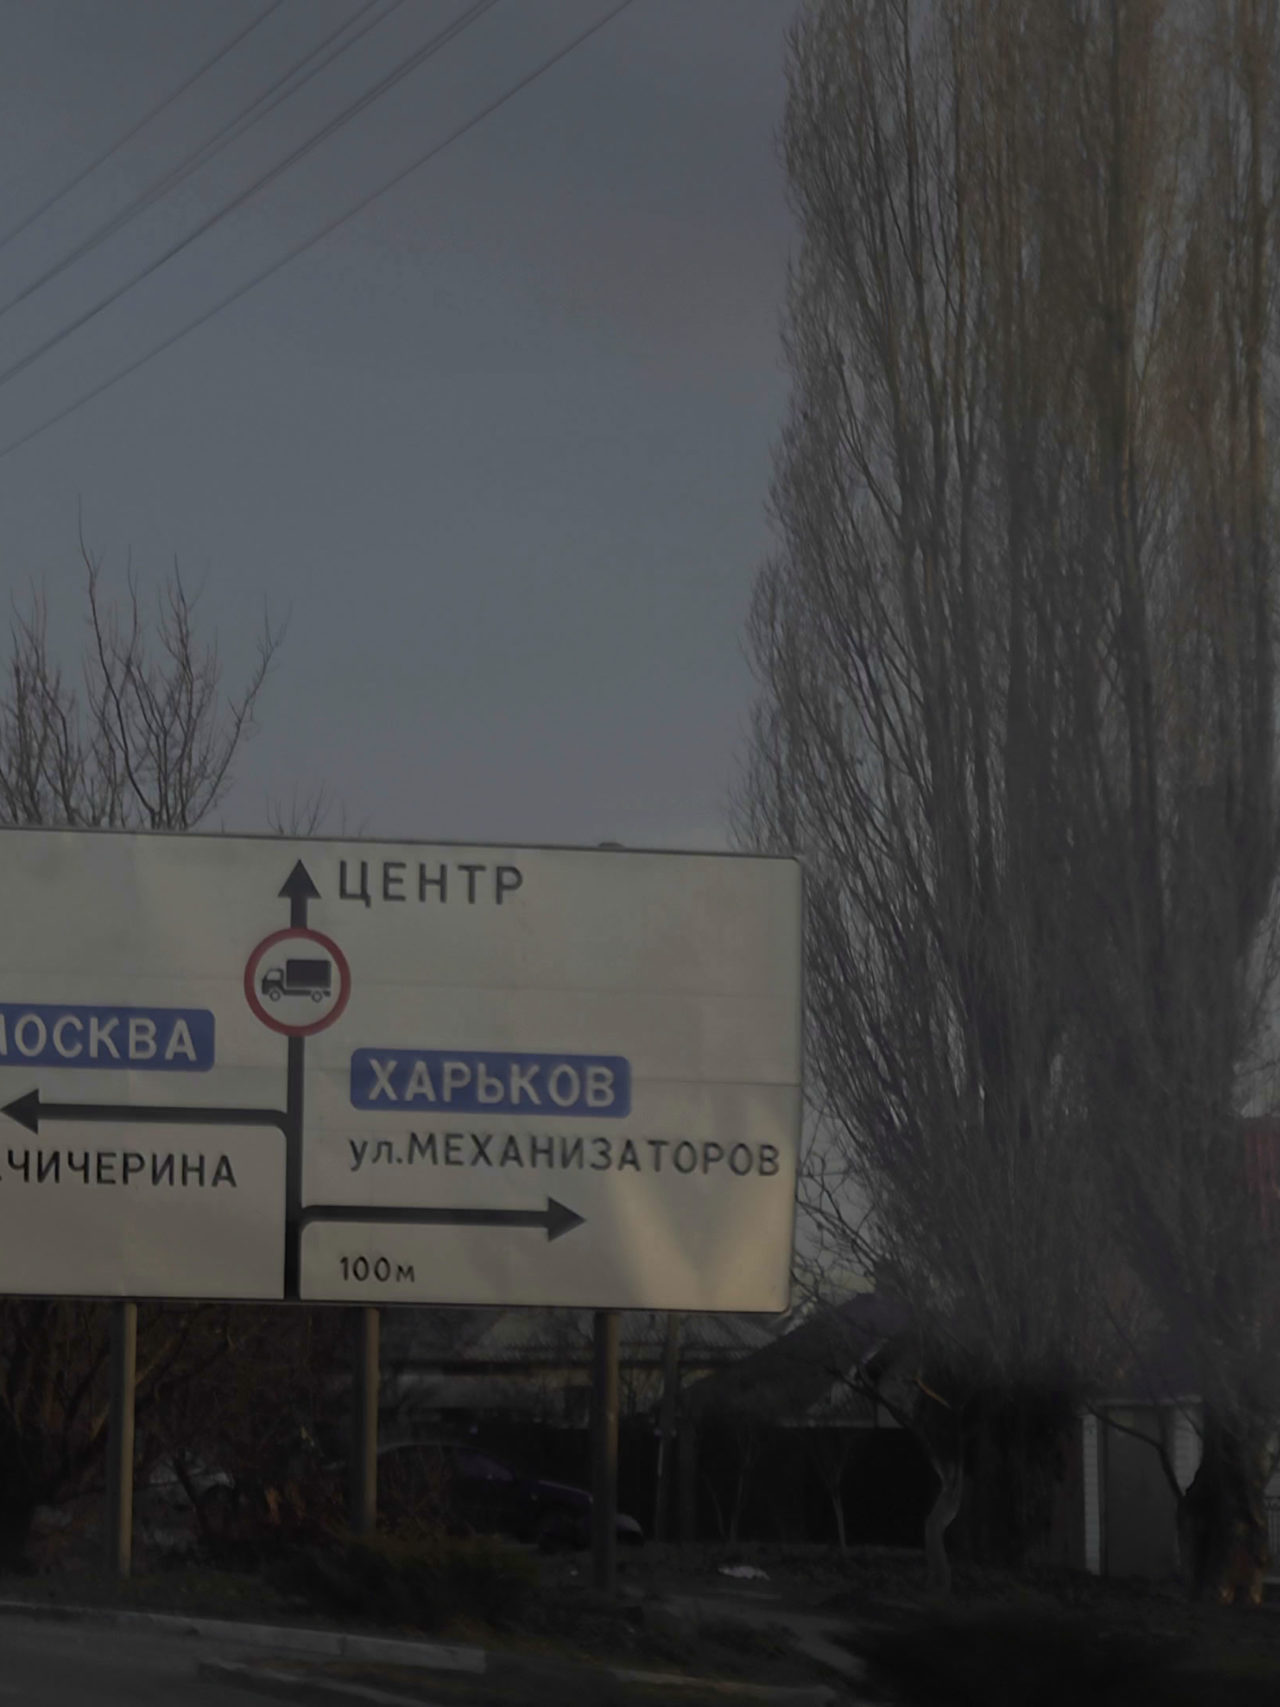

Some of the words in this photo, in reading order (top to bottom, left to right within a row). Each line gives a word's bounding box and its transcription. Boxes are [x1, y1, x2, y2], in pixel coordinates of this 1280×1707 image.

[338, 859, 524, 909] ЦЕНТР
[367, 1056, 616, 1109] ХАРЬКОВ
[349, 1131, 780, 1177] ул.МЕХАНИЗАТОРОВ
[339, 1255, 416, 1284] 100м
